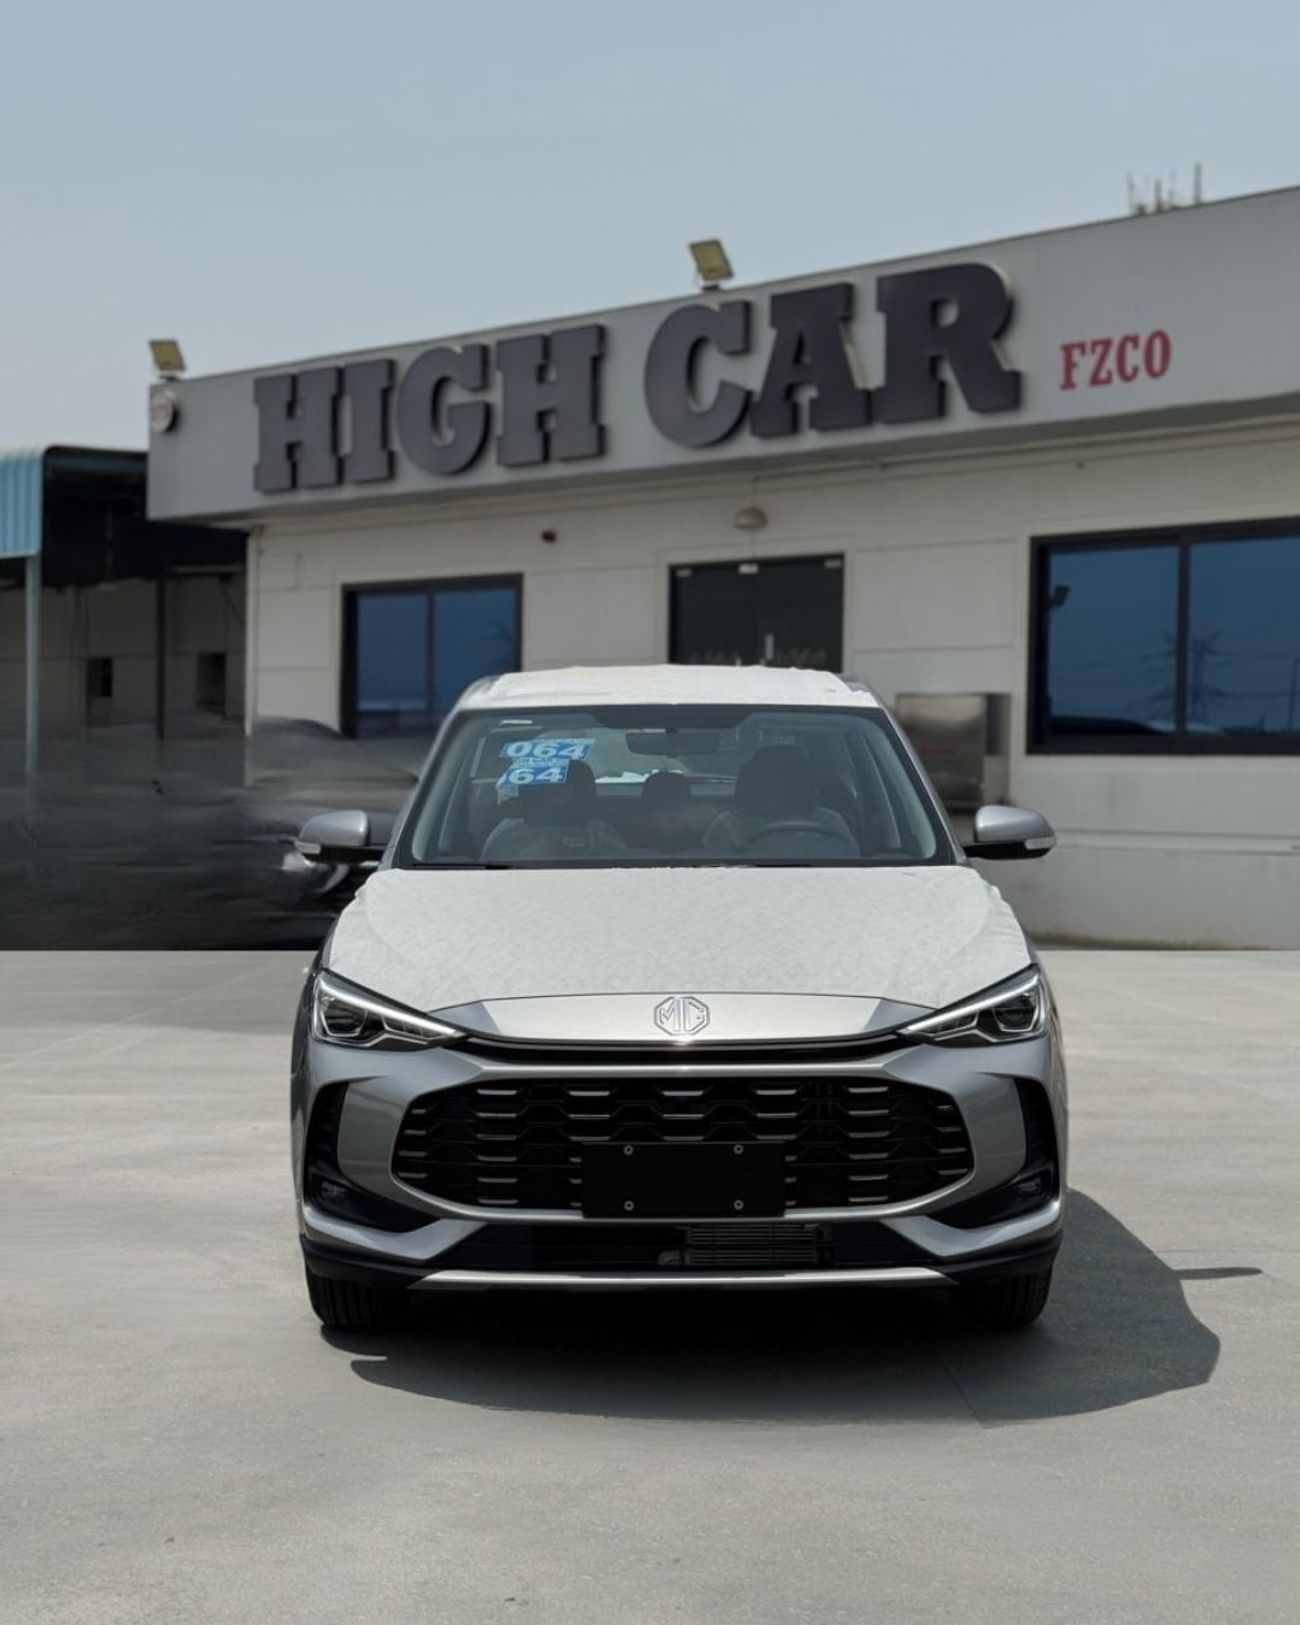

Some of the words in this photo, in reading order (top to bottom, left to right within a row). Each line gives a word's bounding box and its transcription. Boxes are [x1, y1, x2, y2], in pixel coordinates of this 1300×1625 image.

[253, 324, 606, 493] HIGH
[645, 263, 1022, 448] CAR
[1060, 330, 1172, 391] FZCO
[506, 741, 586, 760] 064
[499, 768, 563, 785] 64
[658, 998, 706, 1033] MG
